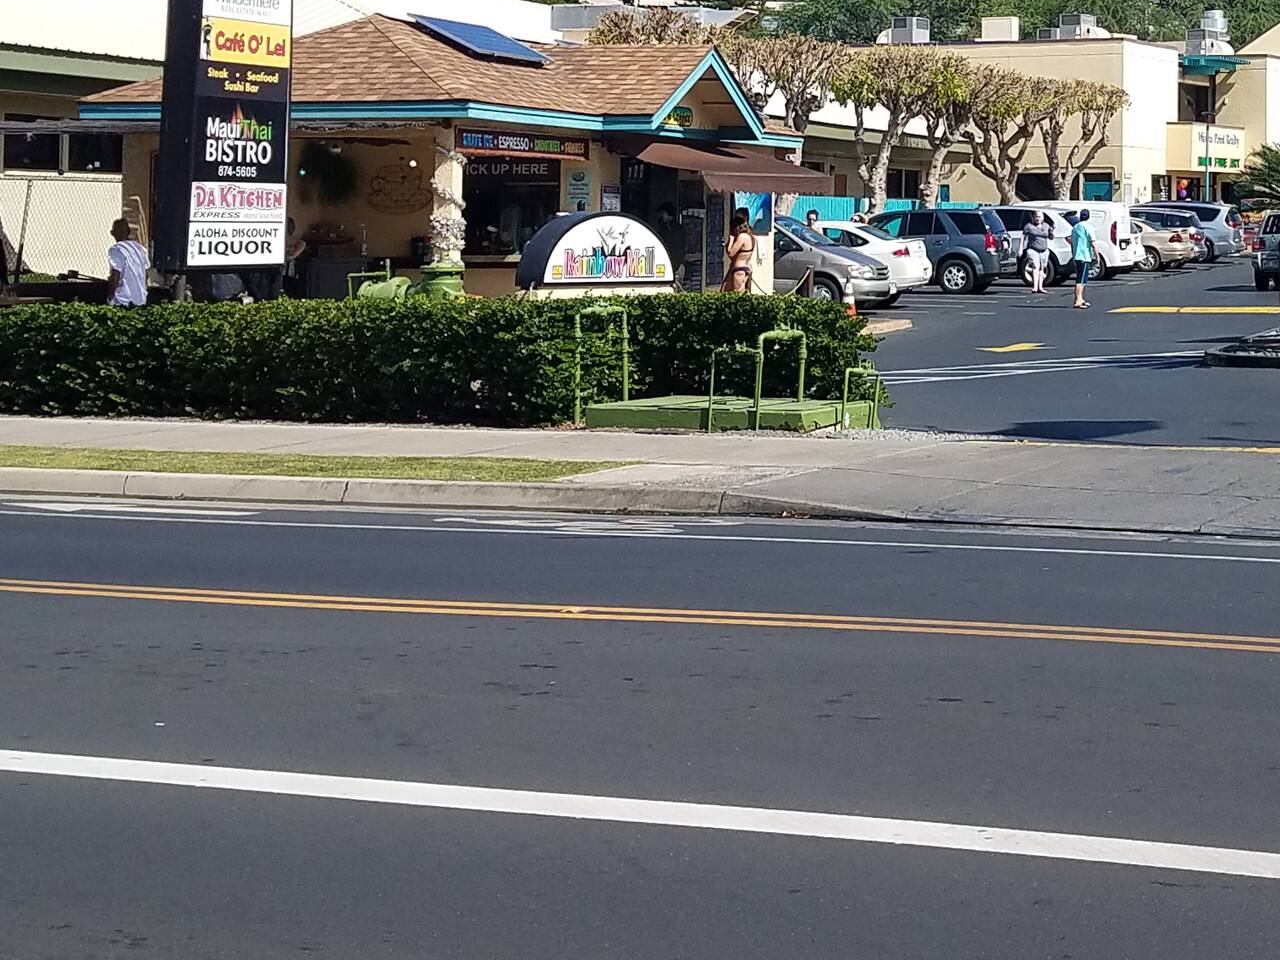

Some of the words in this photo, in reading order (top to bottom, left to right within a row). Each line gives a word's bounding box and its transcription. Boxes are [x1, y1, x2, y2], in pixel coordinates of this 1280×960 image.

[215, 30, 245, 53] Café
[207, 67, 229, 79] Steak
[246, 71, 279, 83] Seafood
[224, 81, 245, 92] Sushi
[245, 82, 259, 93] Bar
[498, 136, 529, 150] ESPRESSO
[205, 139, 272, 164] BISTRO
[218, 165, 257, 177] 874-5605
[463, 163, 488, 176] ICK
[492, 163, 510, 175] UP
[512, 163, 549, 175] HERE
[193, 211, 241, 219] EXPRESS
[193, 228, 228, 238] ALOHA
[232, 228, 279, 238] DISCOUNT
[197, 240, 272, 256] LIQUOR
[564, 246, 626, 279] Rainbow
[626, 246, 655, 278] Mall
